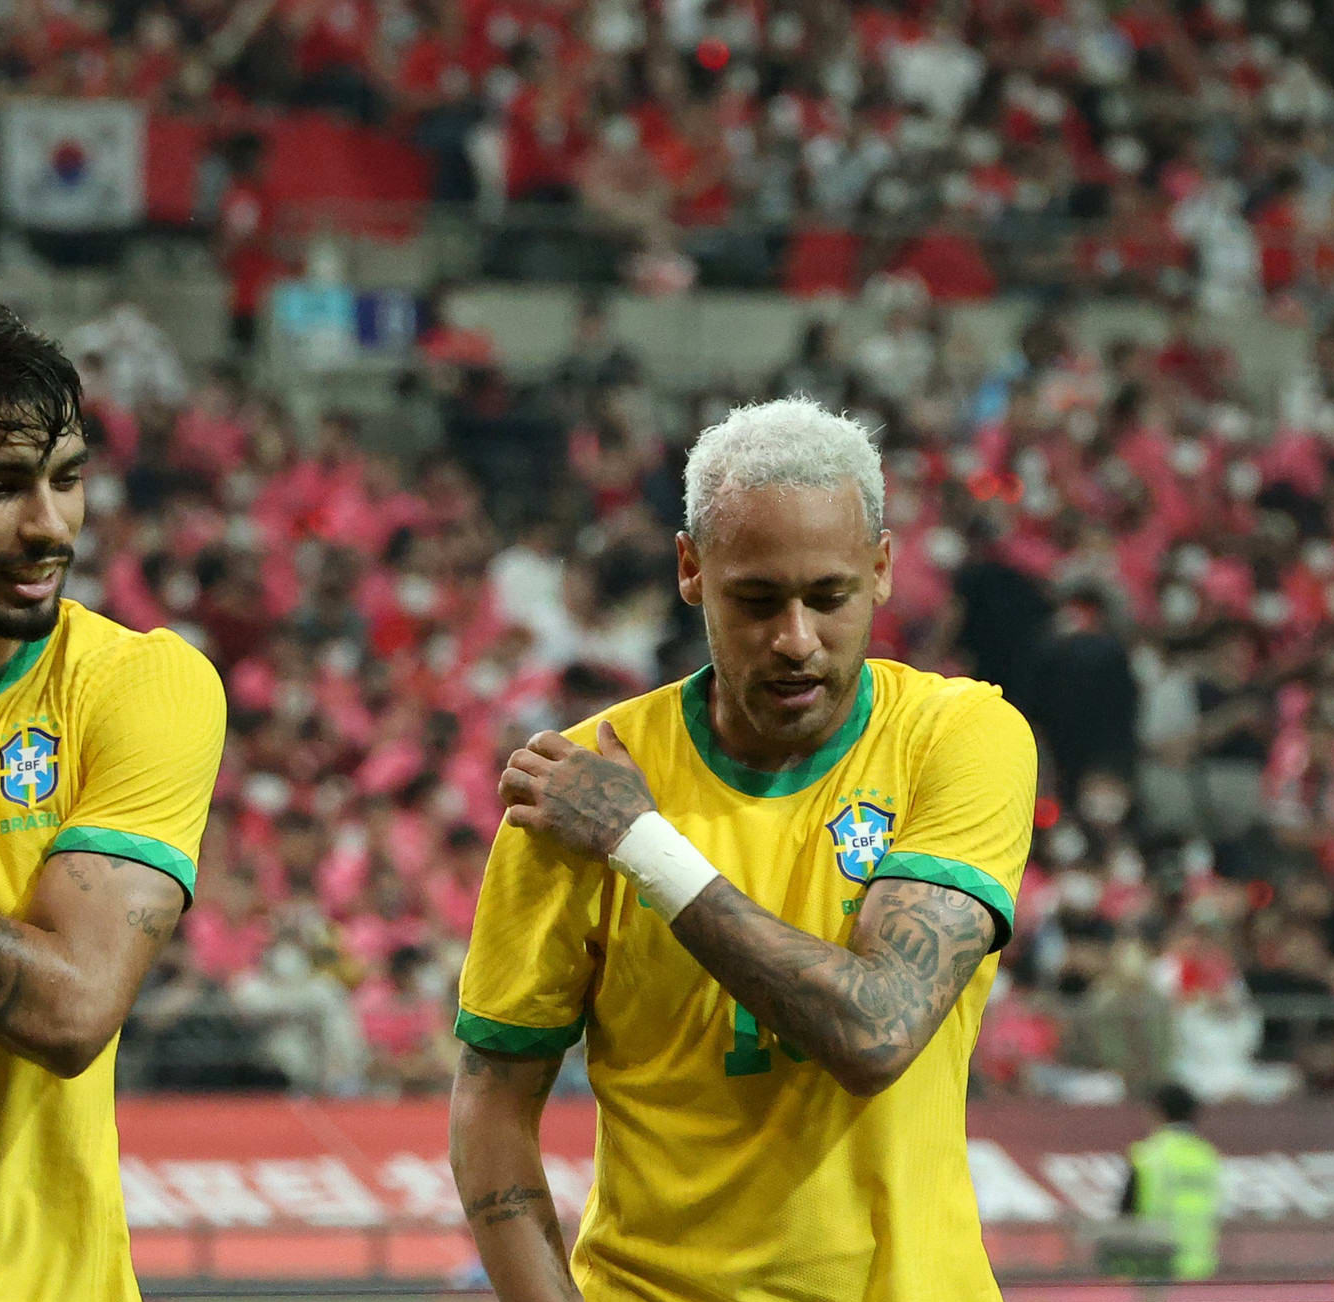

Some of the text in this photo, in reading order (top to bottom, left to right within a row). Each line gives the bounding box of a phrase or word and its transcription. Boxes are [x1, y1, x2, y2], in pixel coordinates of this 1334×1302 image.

[17, 759, 41, 772] CBF
[0, 812, 61, 834] BRASIL
[852, 835, 876, 848] CBF
